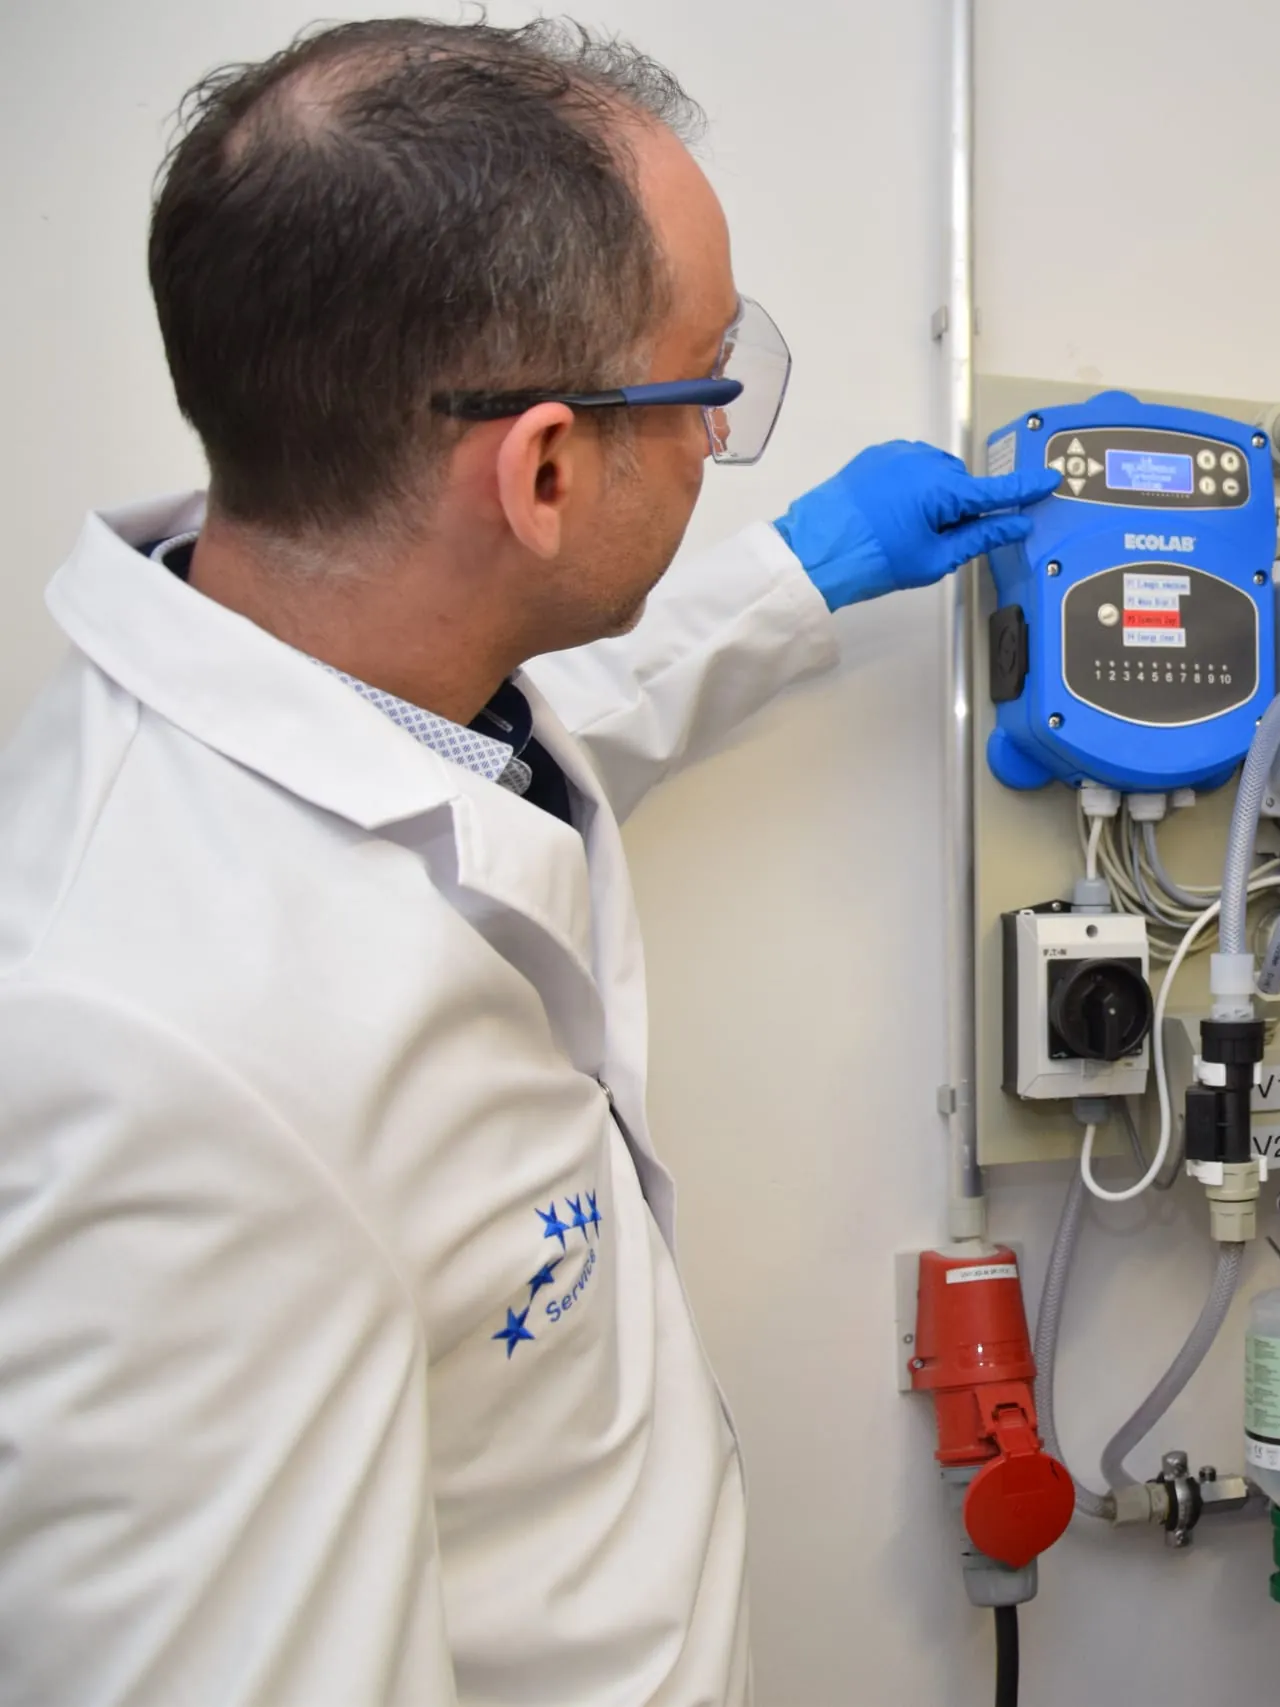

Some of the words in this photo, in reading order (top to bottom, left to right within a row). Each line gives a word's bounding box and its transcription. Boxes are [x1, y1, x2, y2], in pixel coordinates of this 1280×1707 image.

[1124, 532, 1195, 553] ECOLAB
[1096, 670, 1101, 681] 1
[1109, 670, 1116, 681] 2
[1123, 671, 1131, 682] 3
[1137, 671, 1145, 681] 4
[1152, 671, 1159, 682] 5
[1165, 672, 1173, 683] 6
[1180, 672, 1187, 683] 7
[1194, 673, 1201, 683] 8
[1208, 673, 1215, 684] 9
[1220, 674, 1232, 684] 10
[545, 1248, 596, 1322] Service
